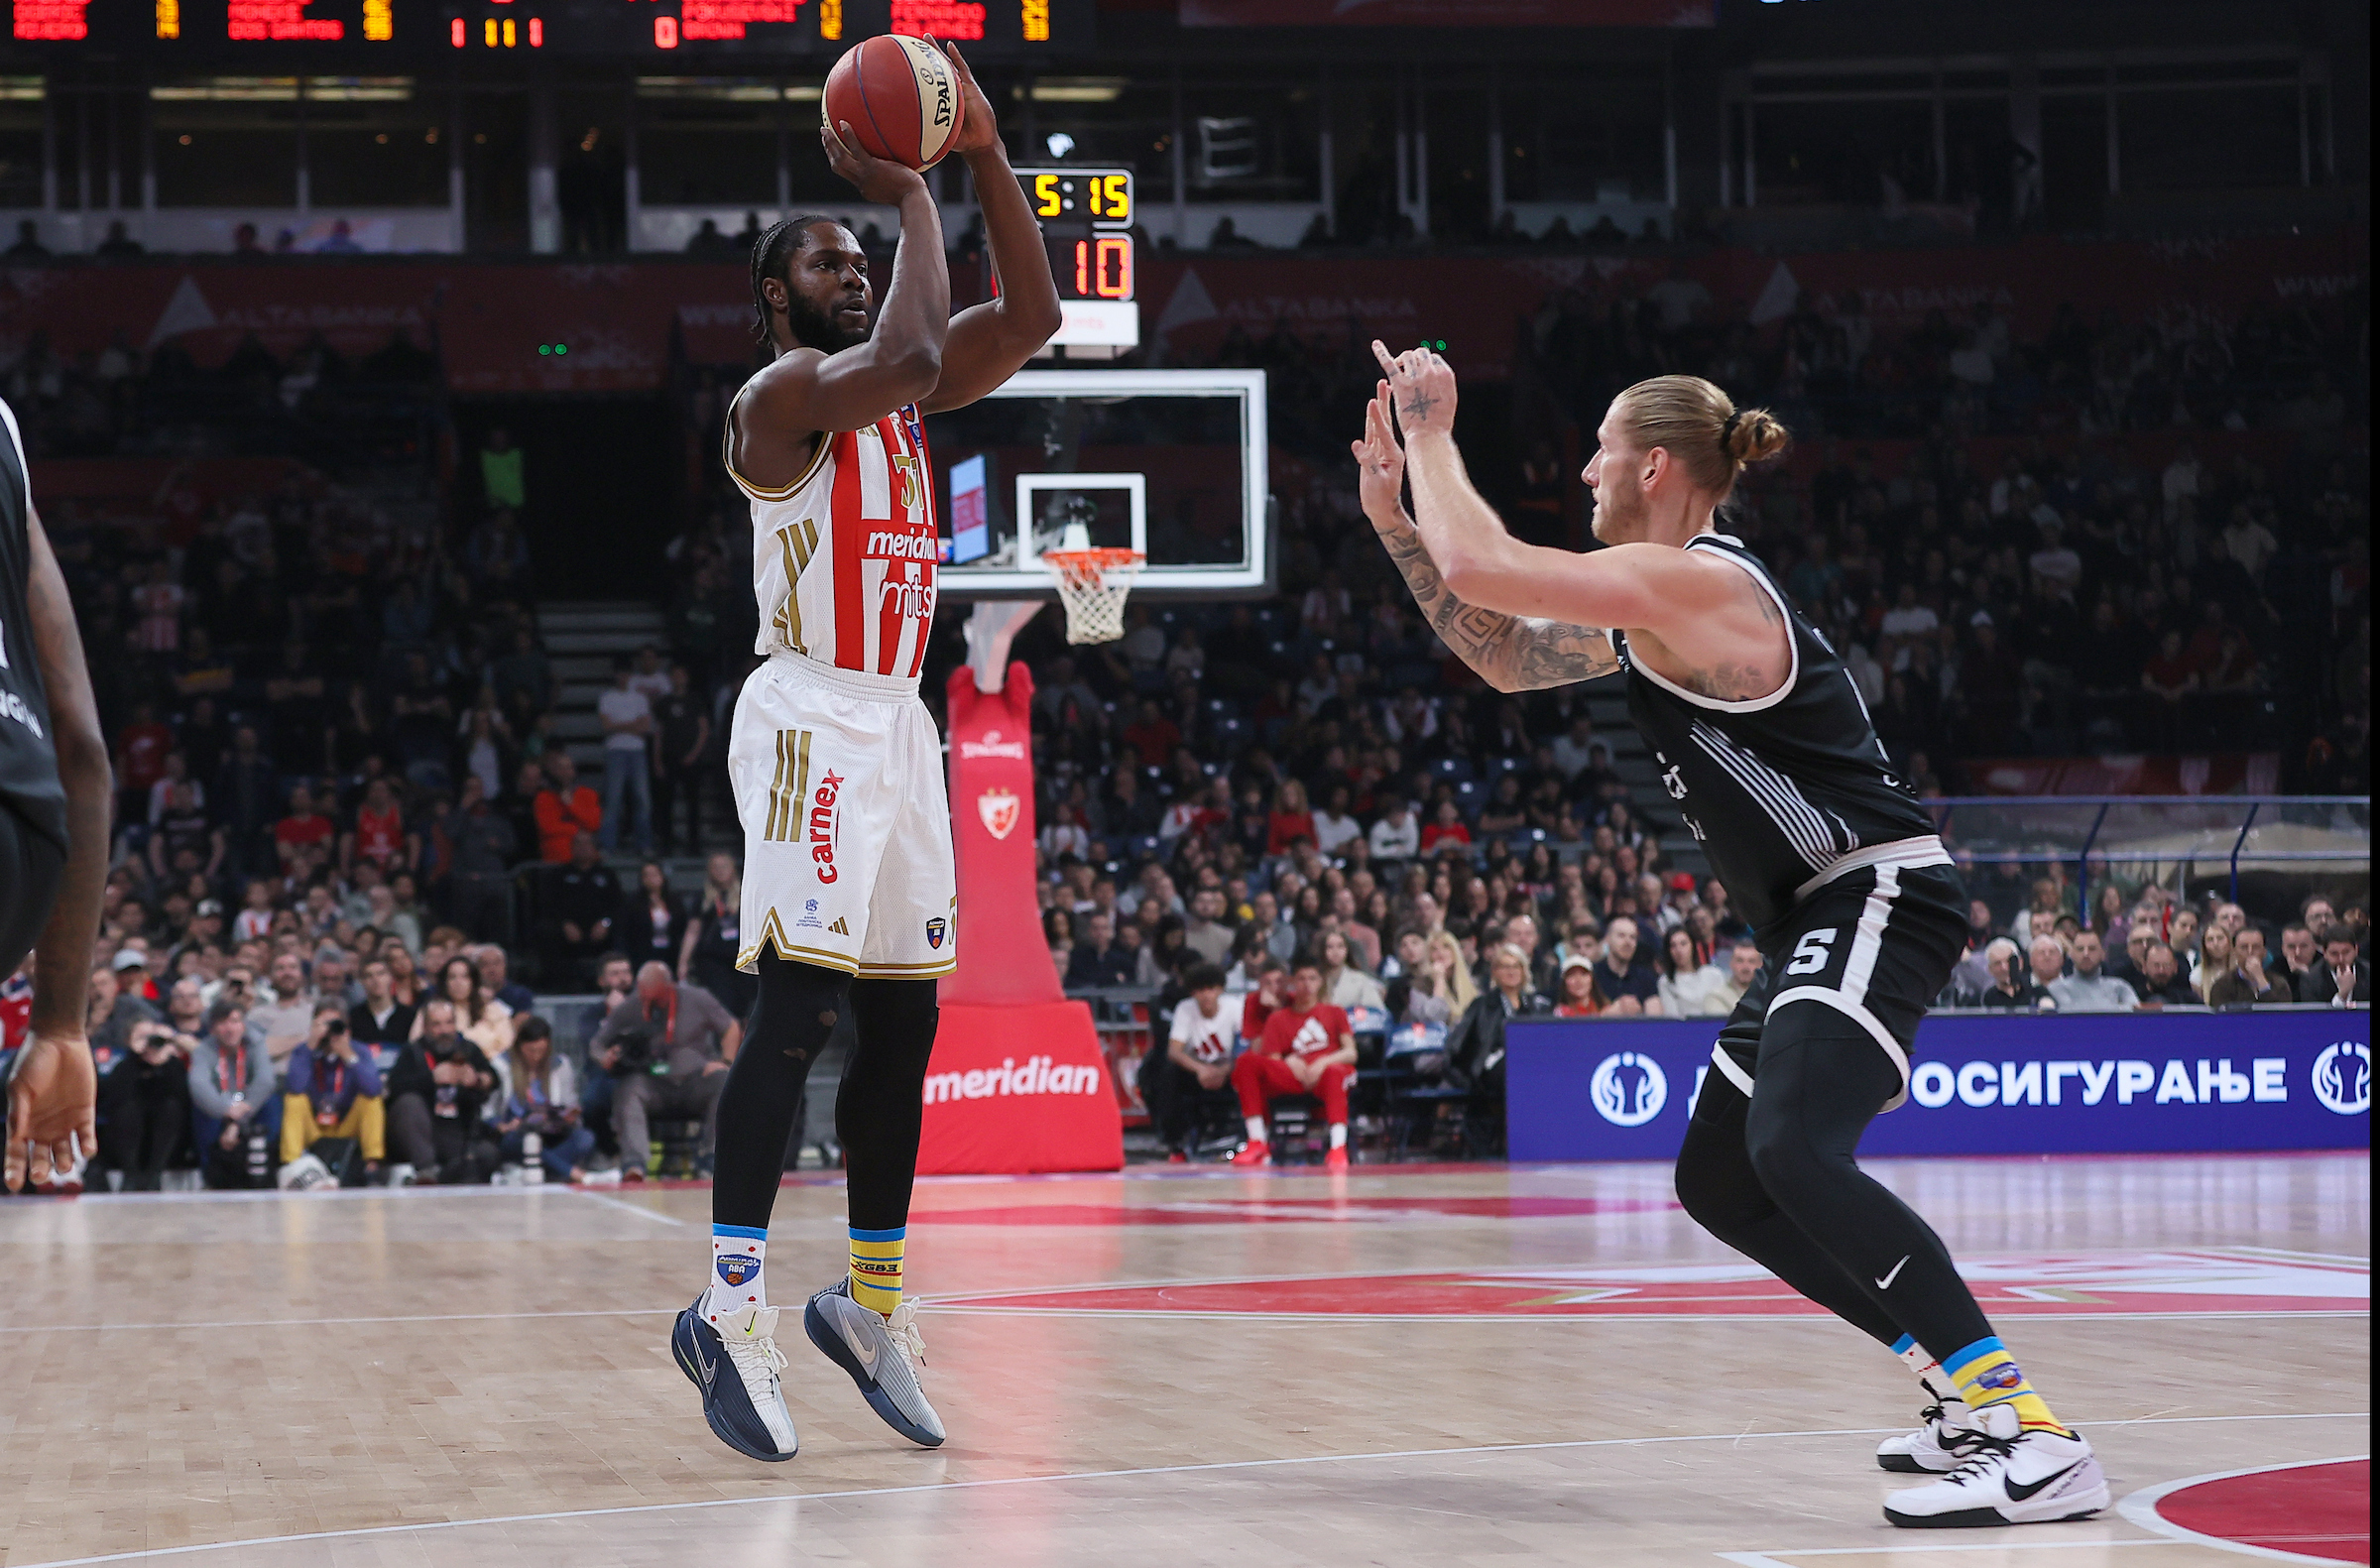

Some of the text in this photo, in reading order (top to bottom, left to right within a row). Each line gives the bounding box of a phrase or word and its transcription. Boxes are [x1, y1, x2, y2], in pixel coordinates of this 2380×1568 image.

[1035, 175, 1129, 217] 5:15
[1076, 239, 1130, 298] 10
[880, 575, 932, 619] mts
[808, 768, 844, 885] carnex
[922, 1055, 1100, 1106] meridian
[1910, 1058, 2288, 1109] ОСИГУРАЊЕ
[728, 1264, 746, 1274] ABA
